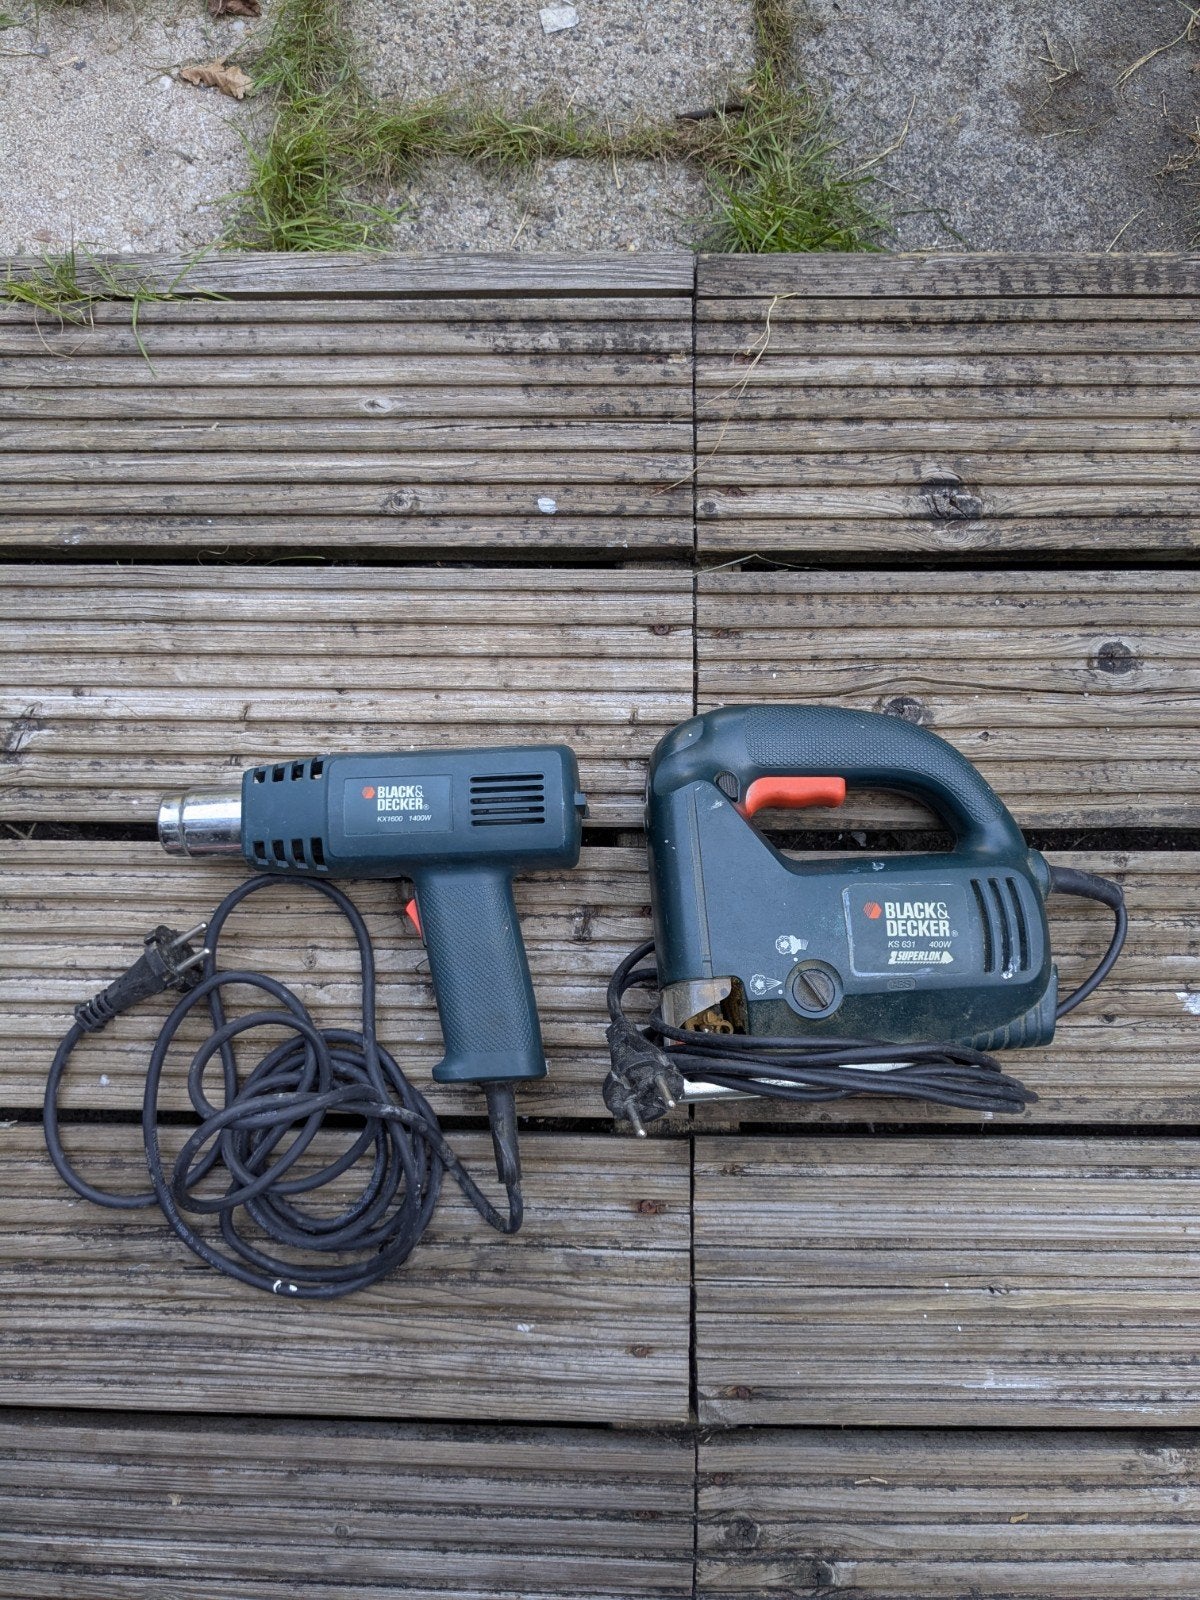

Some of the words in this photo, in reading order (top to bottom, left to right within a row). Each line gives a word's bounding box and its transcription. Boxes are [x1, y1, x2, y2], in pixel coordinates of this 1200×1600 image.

[376, 815, 403, 823] KX1600
[408, 814, 432, 822] 1400W
[888, 940, 900, 948] KS
[901, 940, 916, 949] 631
[929, 940, 952, 949] 400W
[896, 951, 942, 961] SUPERLOK
